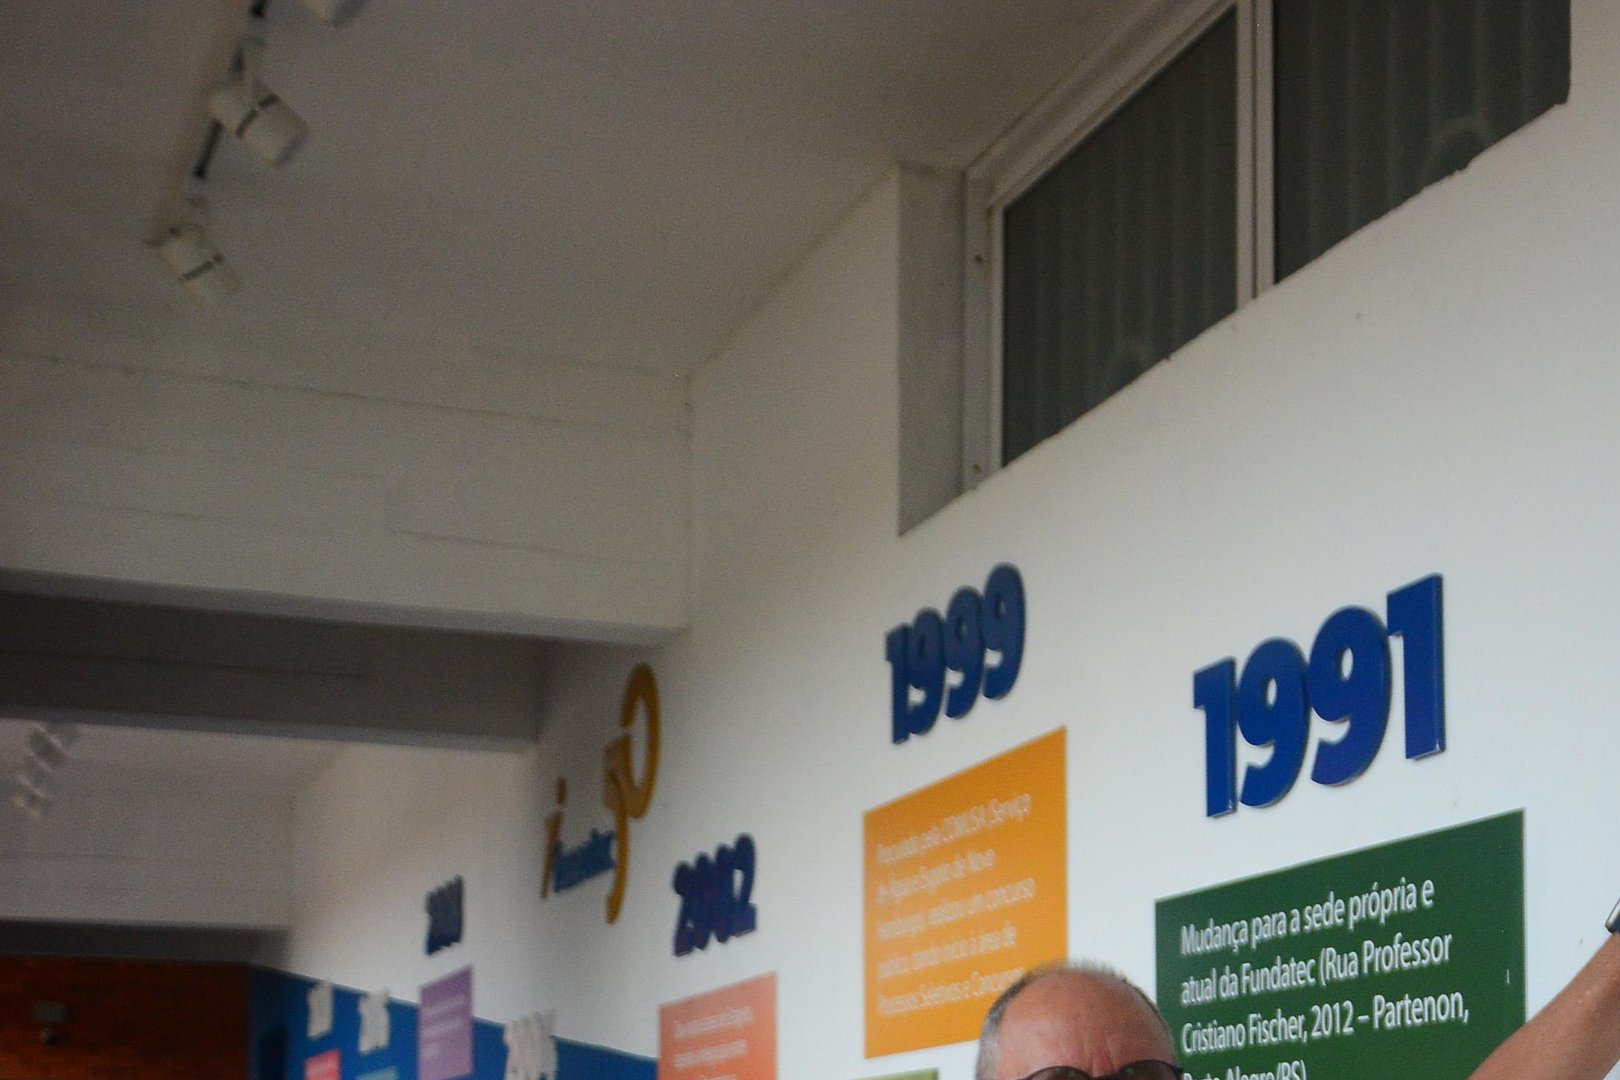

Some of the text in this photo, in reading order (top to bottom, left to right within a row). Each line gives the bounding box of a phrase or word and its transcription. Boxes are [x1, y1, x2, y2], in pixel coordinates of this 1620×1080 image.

[885, 562, 1026, 745] 1999
[1193, 572, 1446, 818] 1991
[1181, 877, 1434, 955] Mudança para a sede própria e
[1182, 932, 1452, 1006] atual da Fundatec (Rua Professor
[1182, 1017, 1244, 1054] Cristiano
[1248, 1006, 1307, 1044] Fischer,
[1311, 1000, 1354, 1038] 2012
[1373, 991, 1469, 1030] Partenon,
